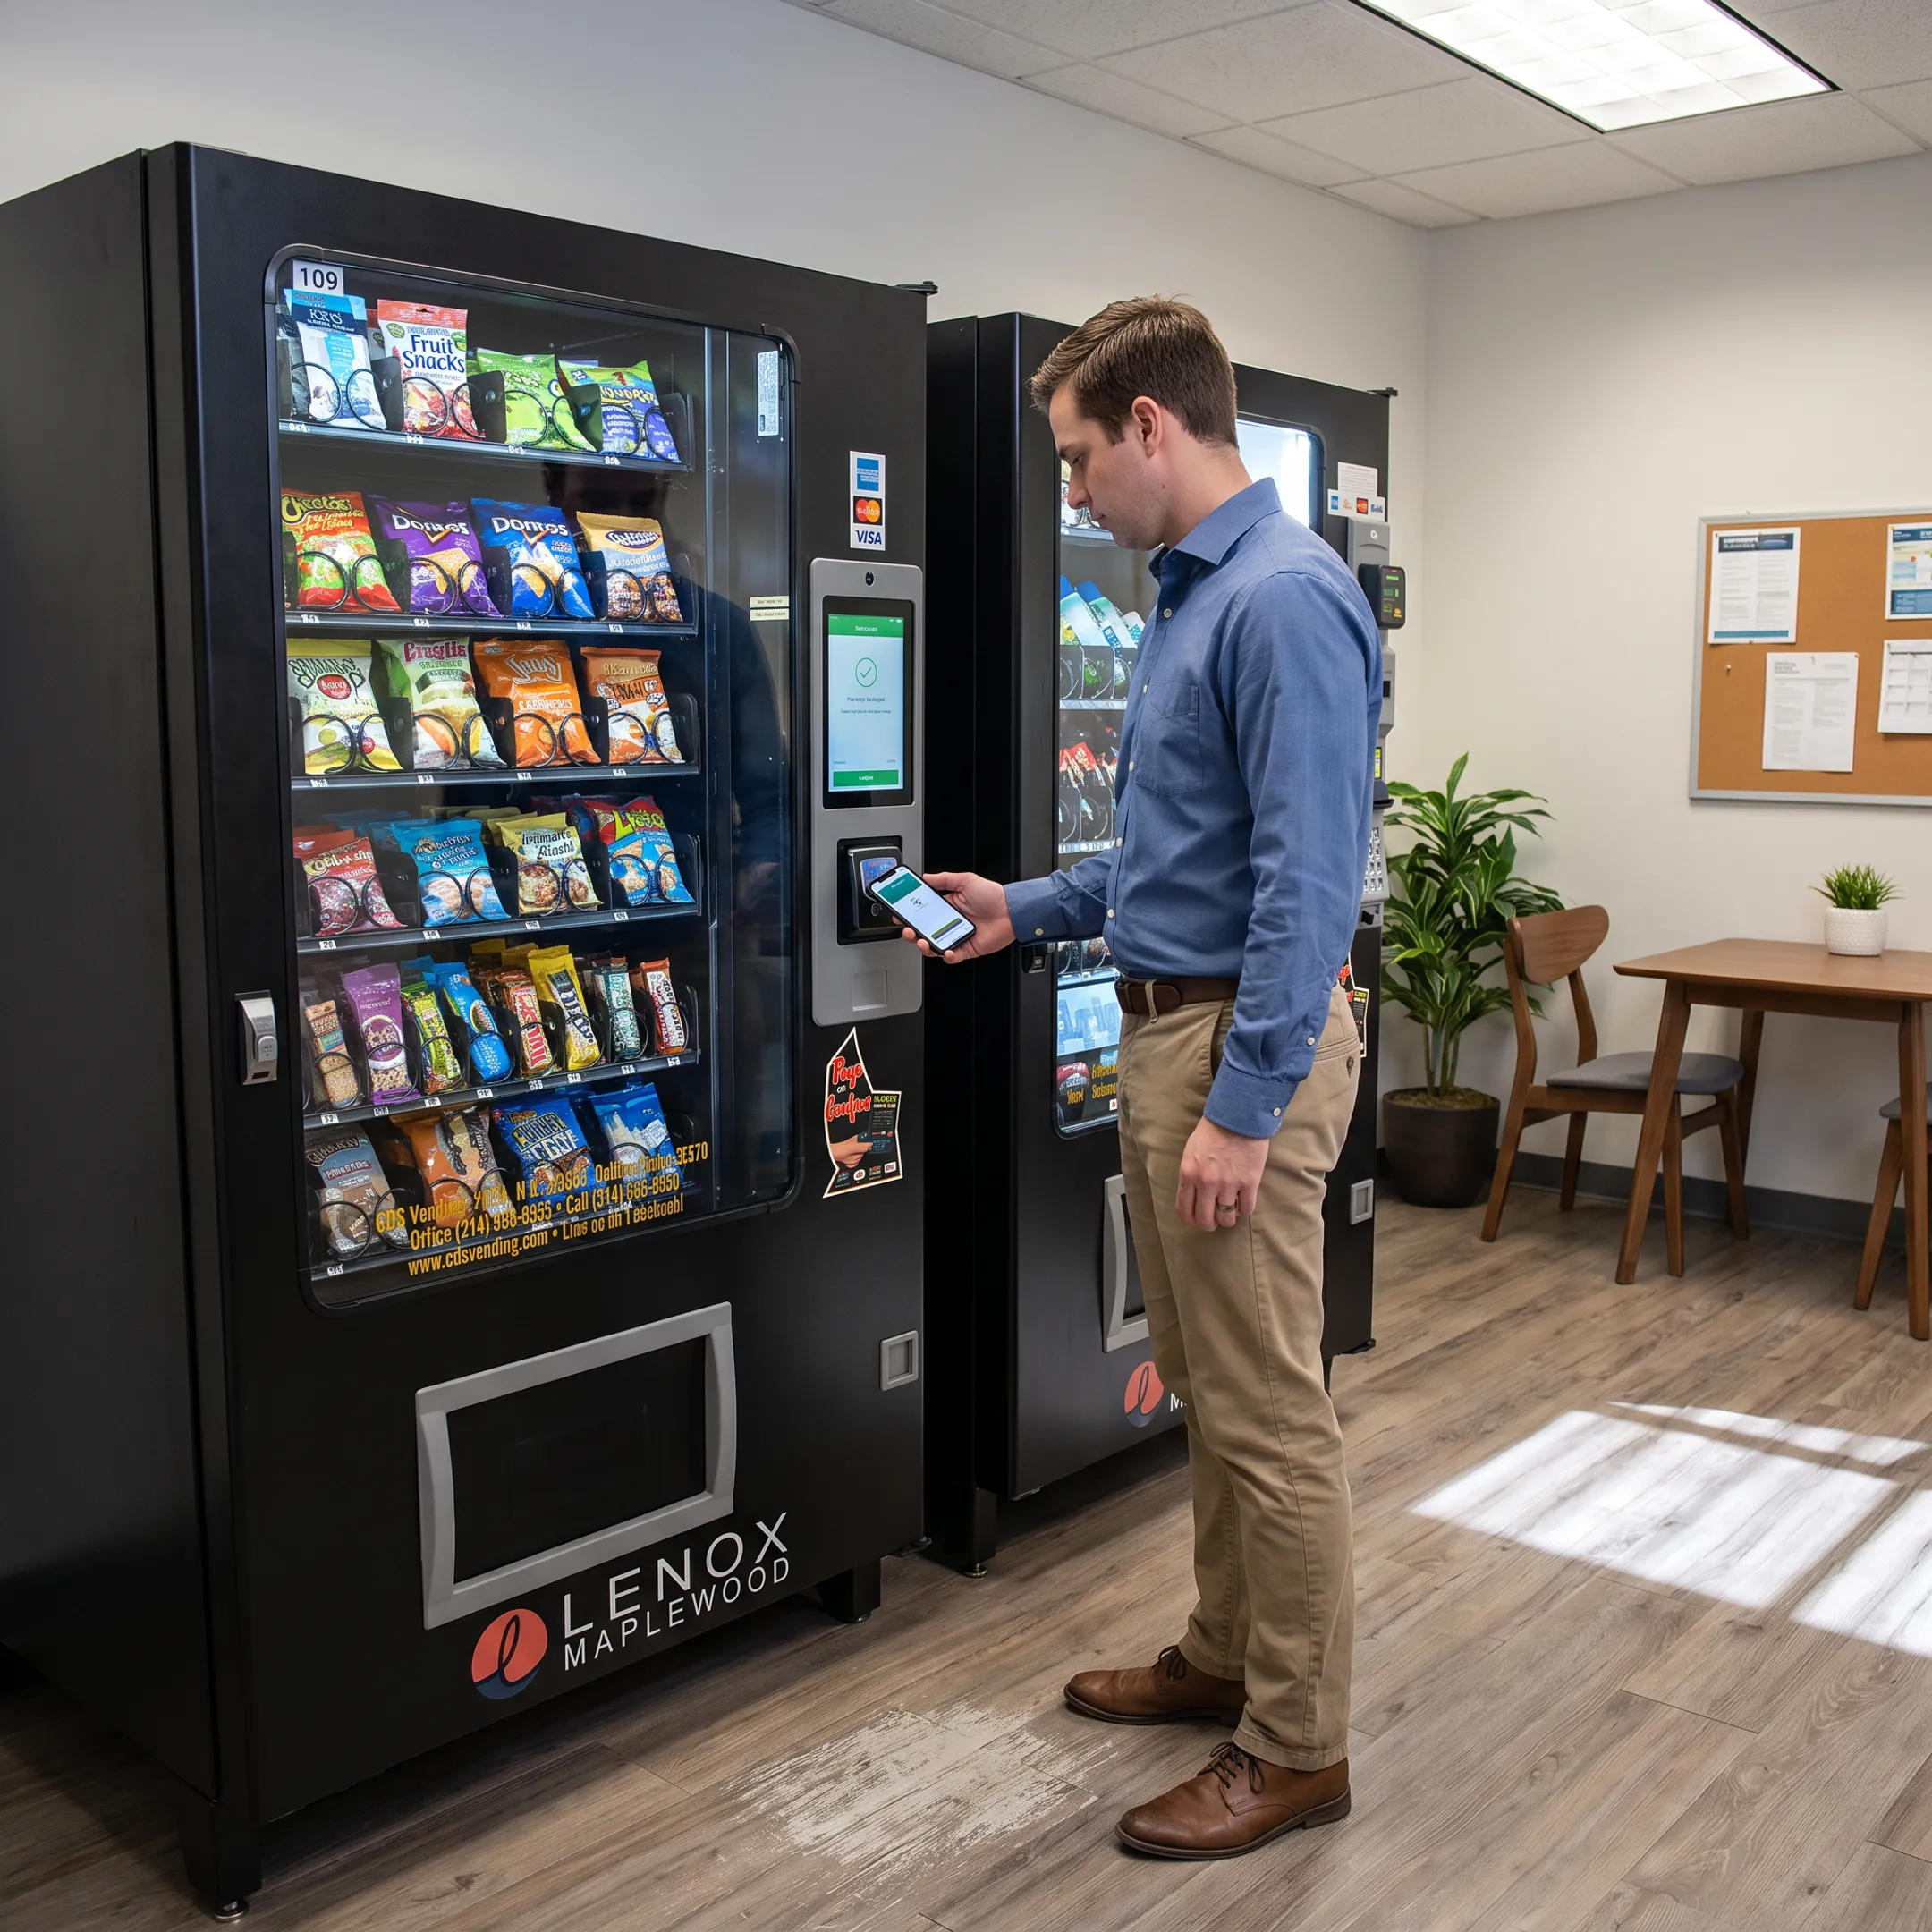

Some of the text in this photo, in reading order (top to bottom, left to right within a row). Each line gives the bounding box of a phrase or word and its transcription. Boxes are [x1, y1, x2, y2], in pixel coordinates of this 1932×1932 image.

[300, 267, 338, 290] 109
[411, 335, 453, 354] Fruit
[402, 351, 465, 374] Snacks
[855, 530, 882, 545] VISA
[455, 1214, 489, 1244] (214)
[566, 1191, 589, 1216] Call
[592, 1184, 623, 1212] (314)
[408, 1230, 548, 1276] www.cdsvending.com
[564, 1512, 788, 1639] LENOX
[564, 1556, 789, 1671] MAPLEWOOD
